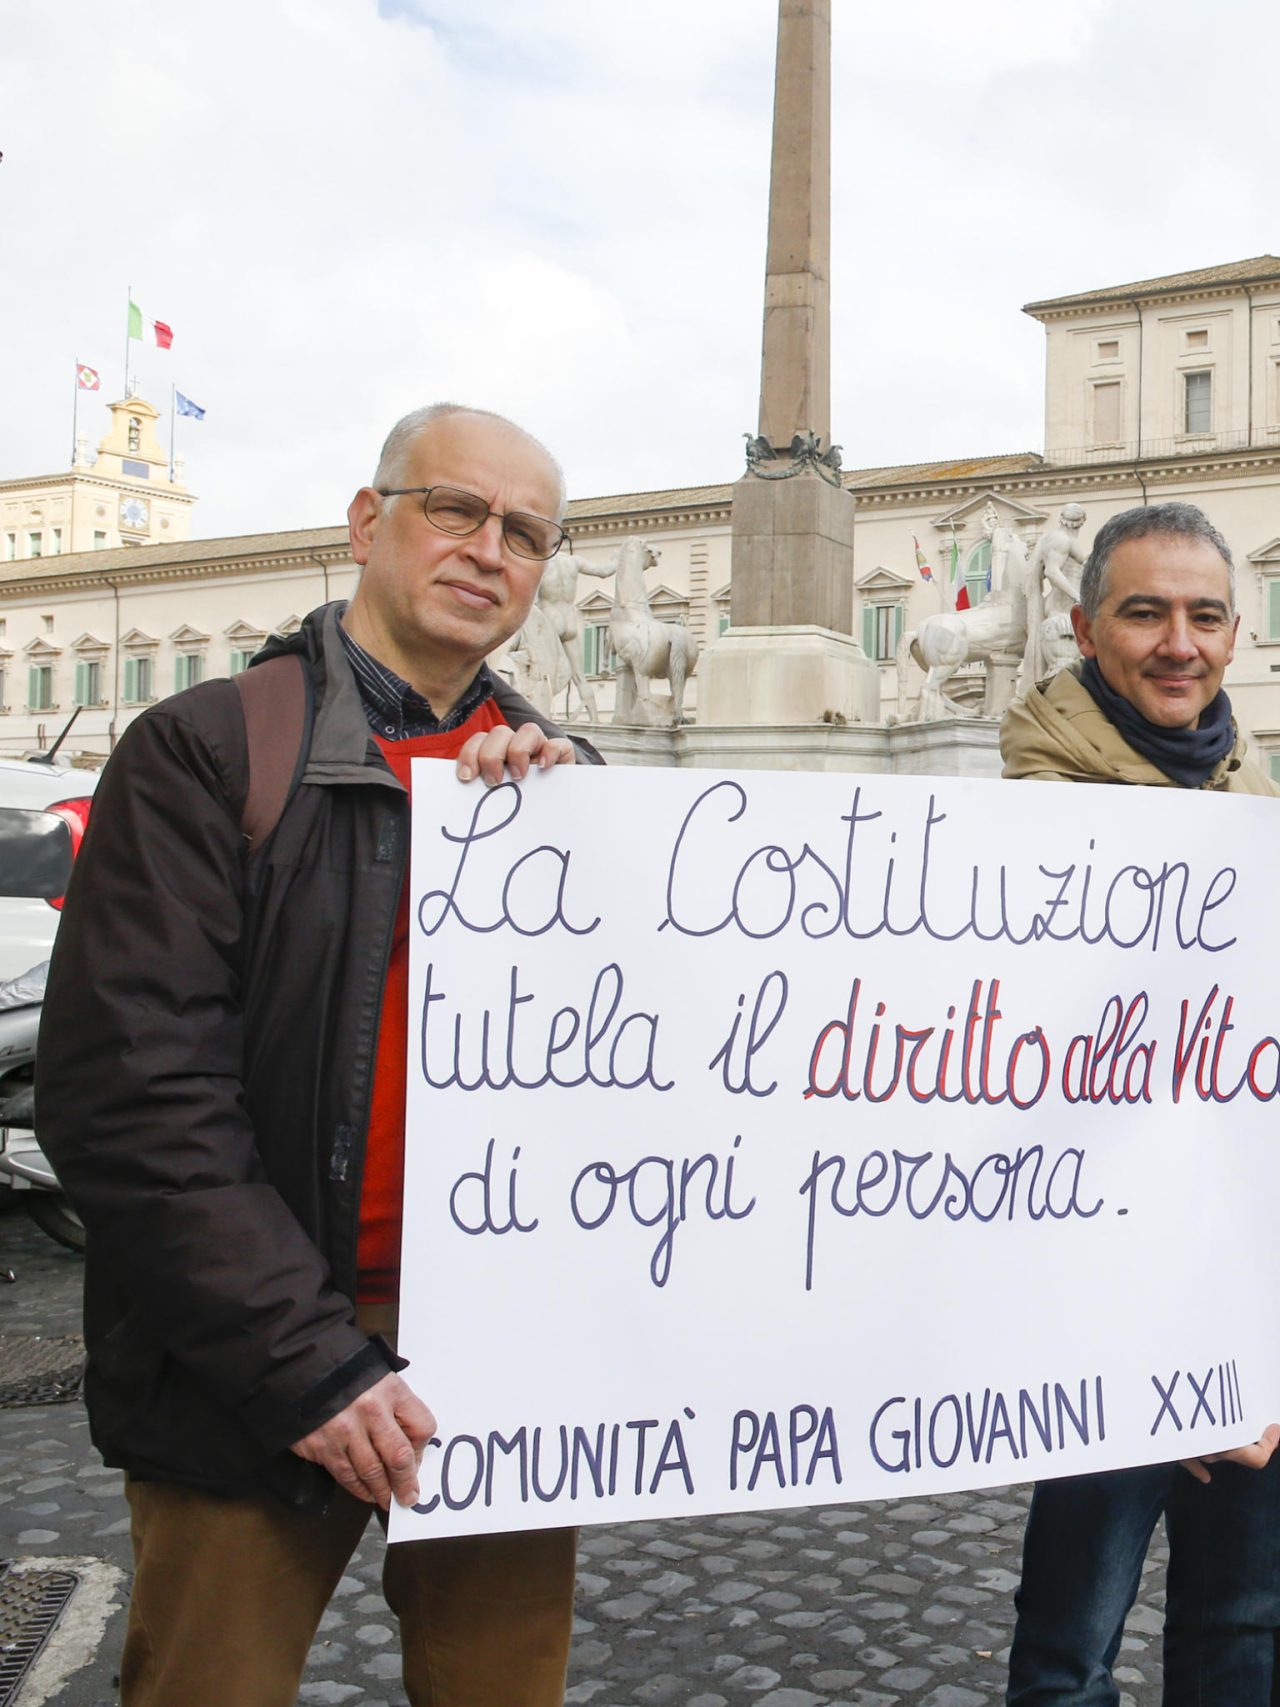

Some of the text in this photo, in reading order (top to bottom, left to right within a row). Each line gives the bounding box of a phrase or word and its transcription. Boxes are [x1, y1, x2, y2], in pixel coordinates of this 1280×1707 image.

[418, 780, 1238, 953] La Costituzione
[421, 962, 676, 1092] tutela
[709, 970, 789, 1098] il
[803, 977, 1051, 1107] diritto
[1062, 991, 1155, 1105] alla
[449, 1134, 1129, 1292] di ogni persona.
[729, 1403, 843, 1493] PAPA
[868, 1374, 1105, 1474] GIOVANNI
[1150, 1358, 1244, 1437] XXIII
